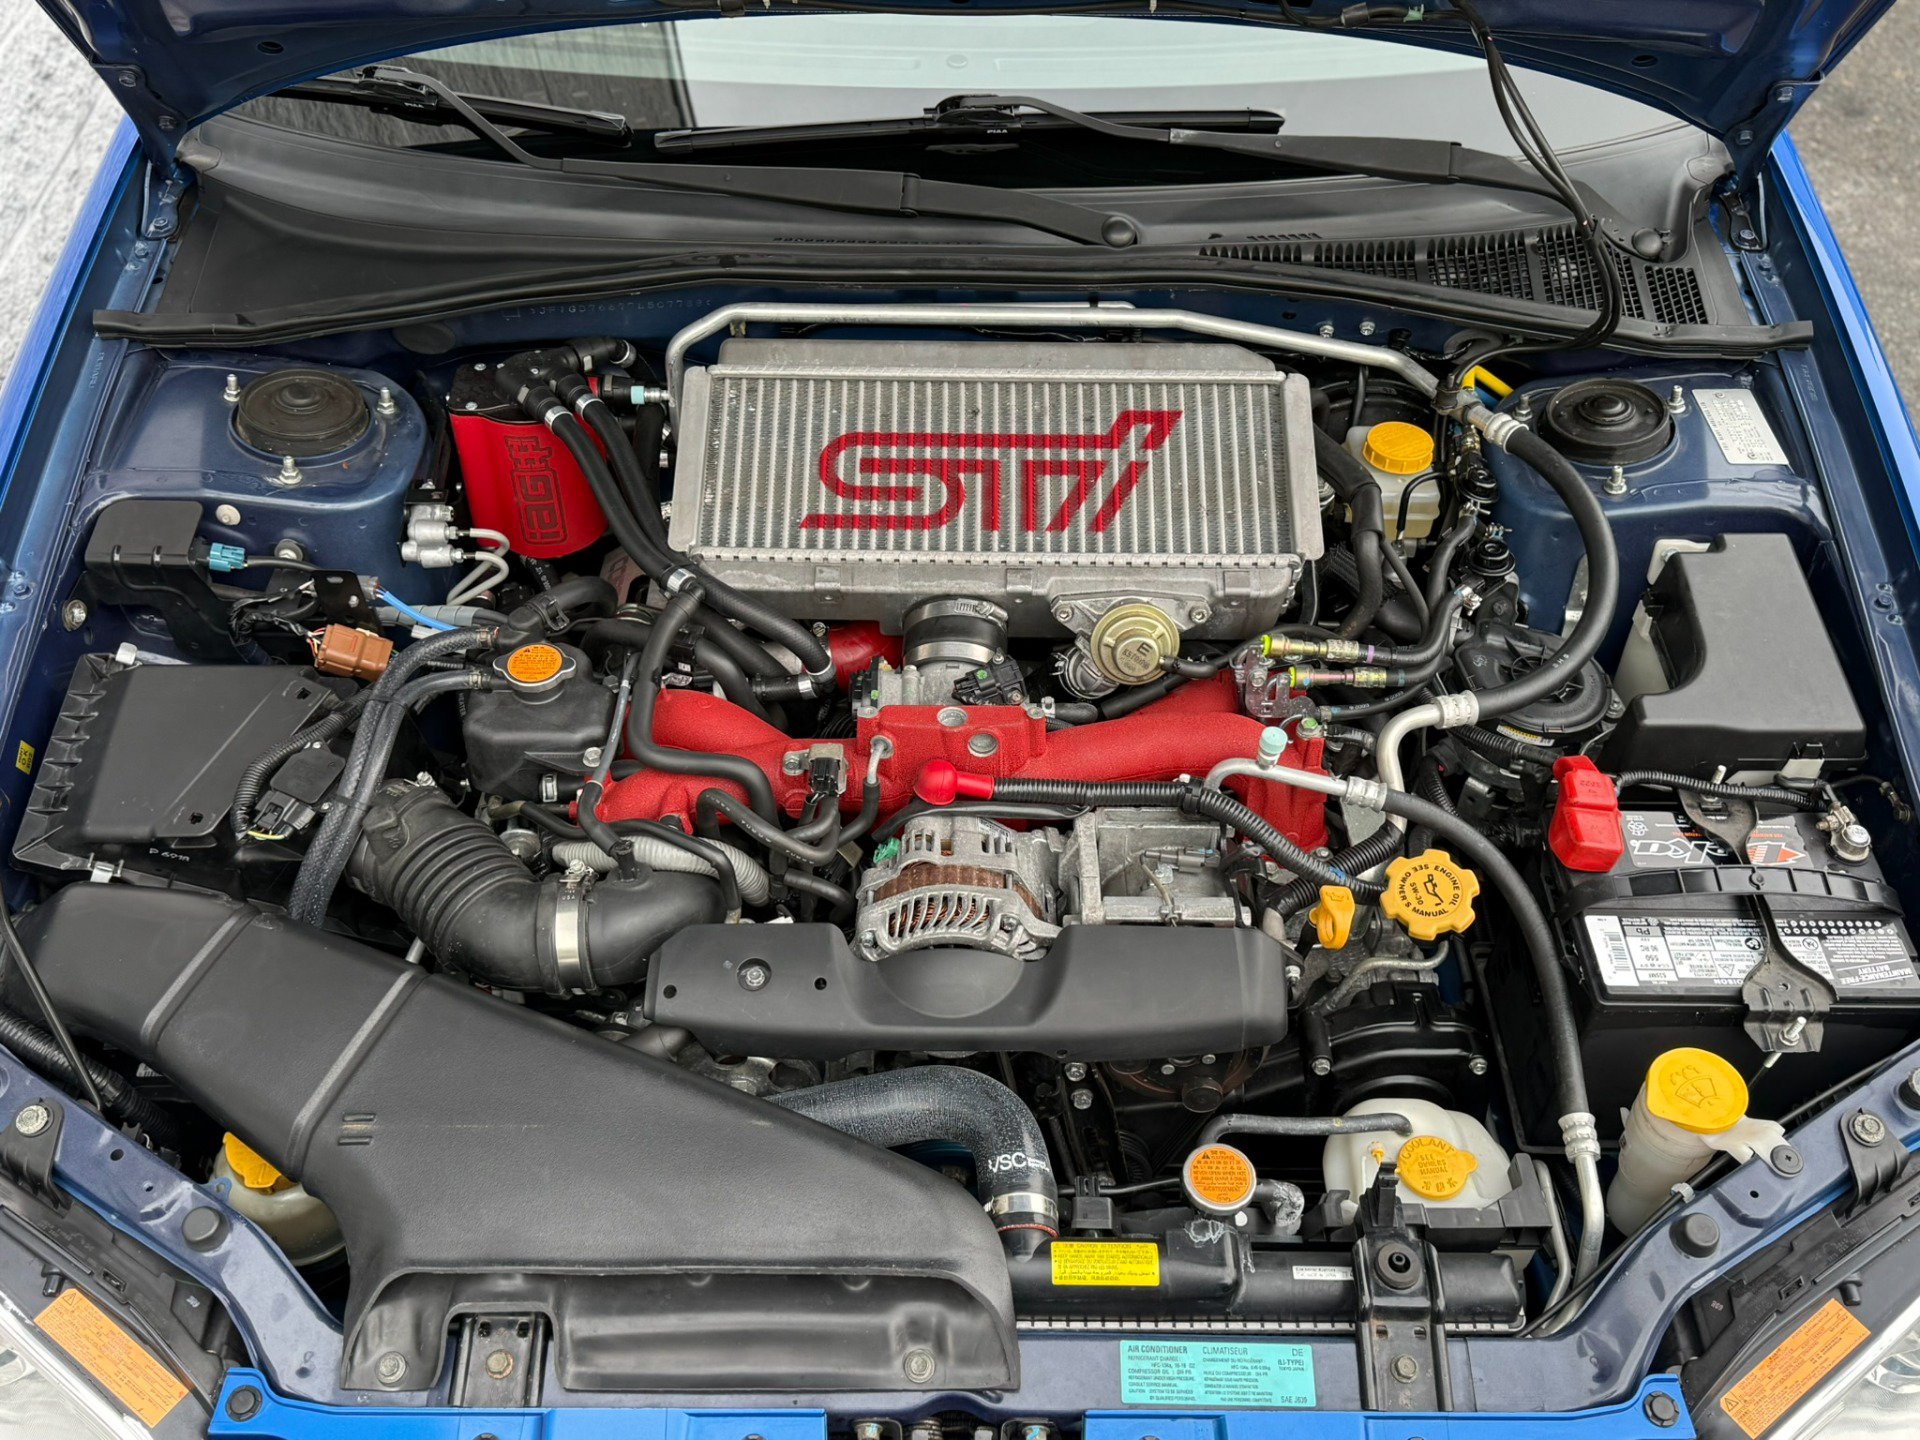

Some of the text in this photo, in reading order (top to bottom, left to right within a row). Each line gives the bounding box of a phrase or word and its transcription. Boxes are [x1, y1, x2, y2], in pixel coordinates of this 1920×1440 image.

[1136, 641, 1153, 657] E
[1412, 864, 1429, 872] SEE
[1434, 865, 1460, 906] ENGINE OIL
[1412, 907, 1449, 917] MANUAL
[1635, 927, 1651, 935] Pb
[1857, 965, 1890, 975] BATTERY
[1840, 968, 1912, 985] MAINTENANCE-FREE
[1401, 1139, 1455, 1159] COOLANT
[1128, 1345, 1139, 1353] AIR
[1141, 1346, 1188, 1354] CONDITIONER
[1202, 1347, 1248, 1355] CLIMATISEUR
